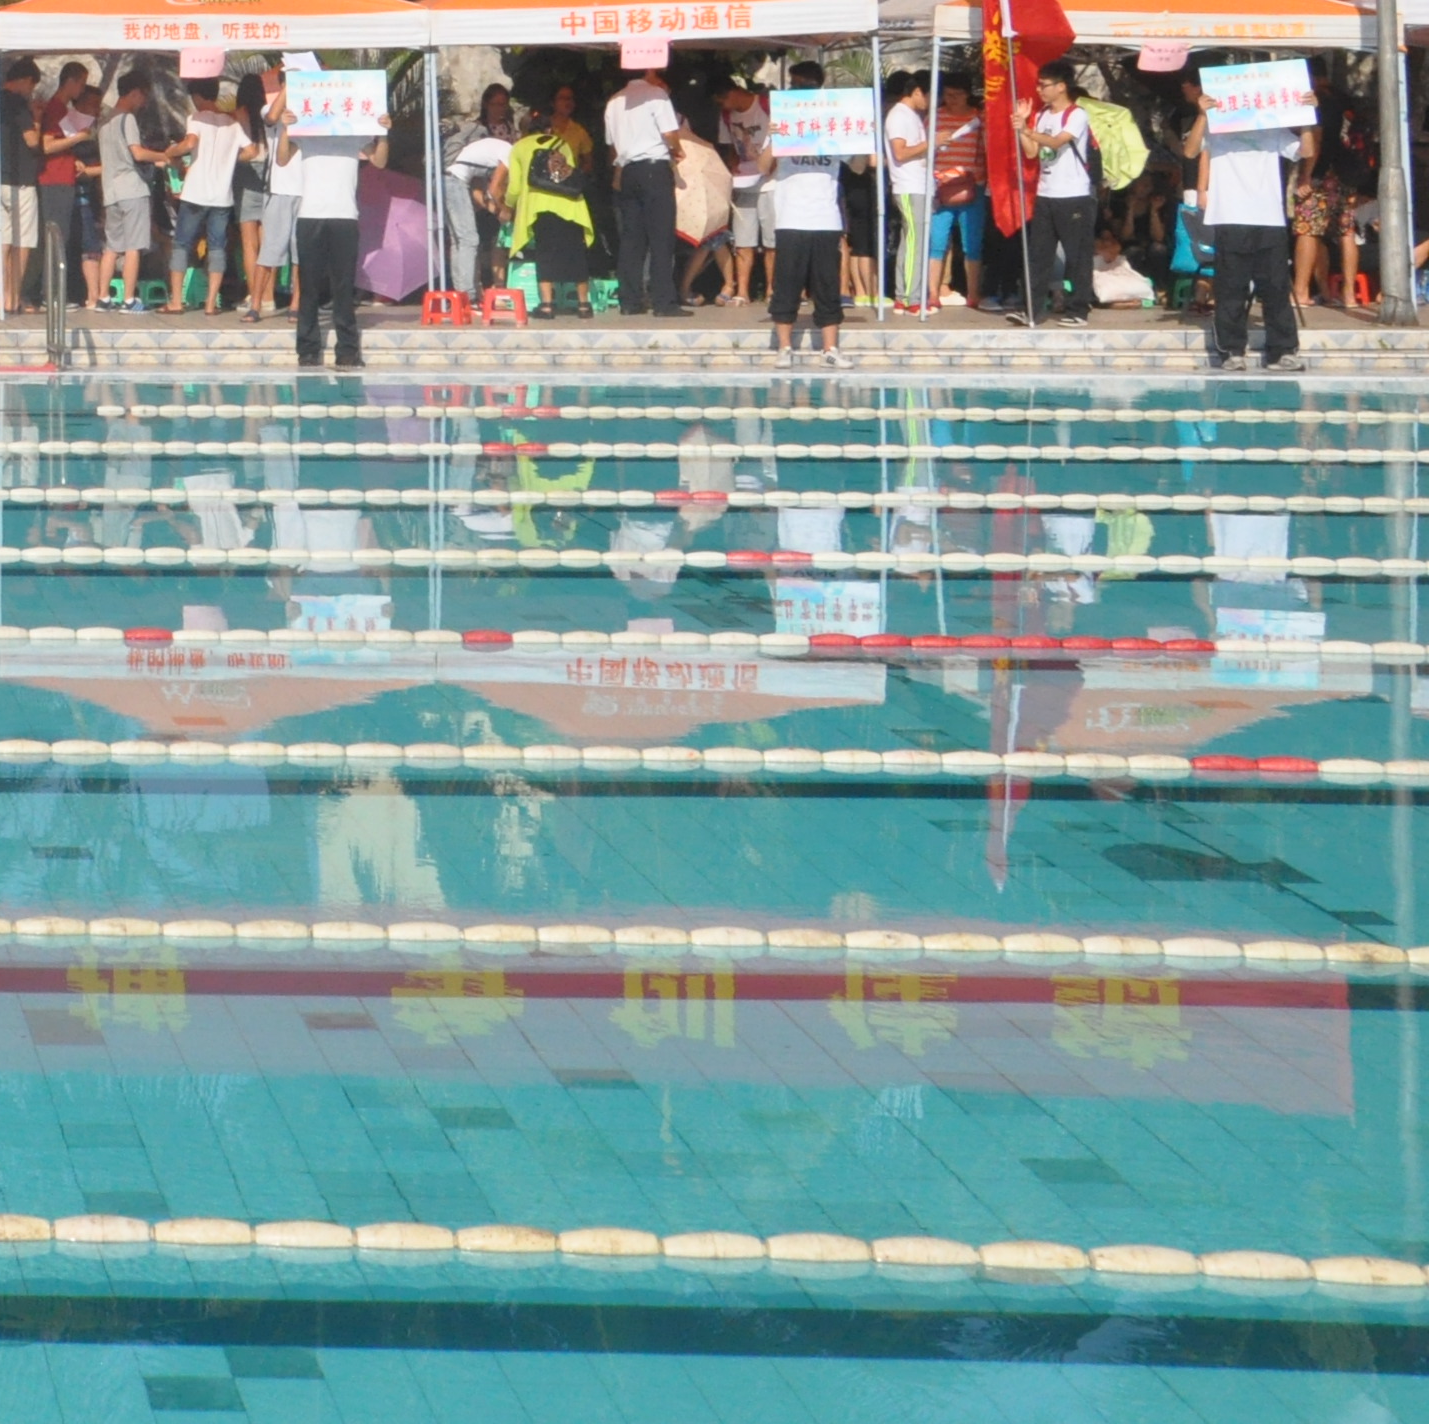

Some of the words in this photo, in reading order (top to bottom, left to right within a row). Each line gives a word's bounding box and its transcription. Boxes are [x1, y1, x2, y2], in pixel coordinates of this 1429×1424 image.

[560, 3, 754, 37] 中国移动通信
[300, 96, 376, 118] 美术学院
[777, 116, 869, 138] 教育科学学院
[790, 155, 833, 167] VANS
